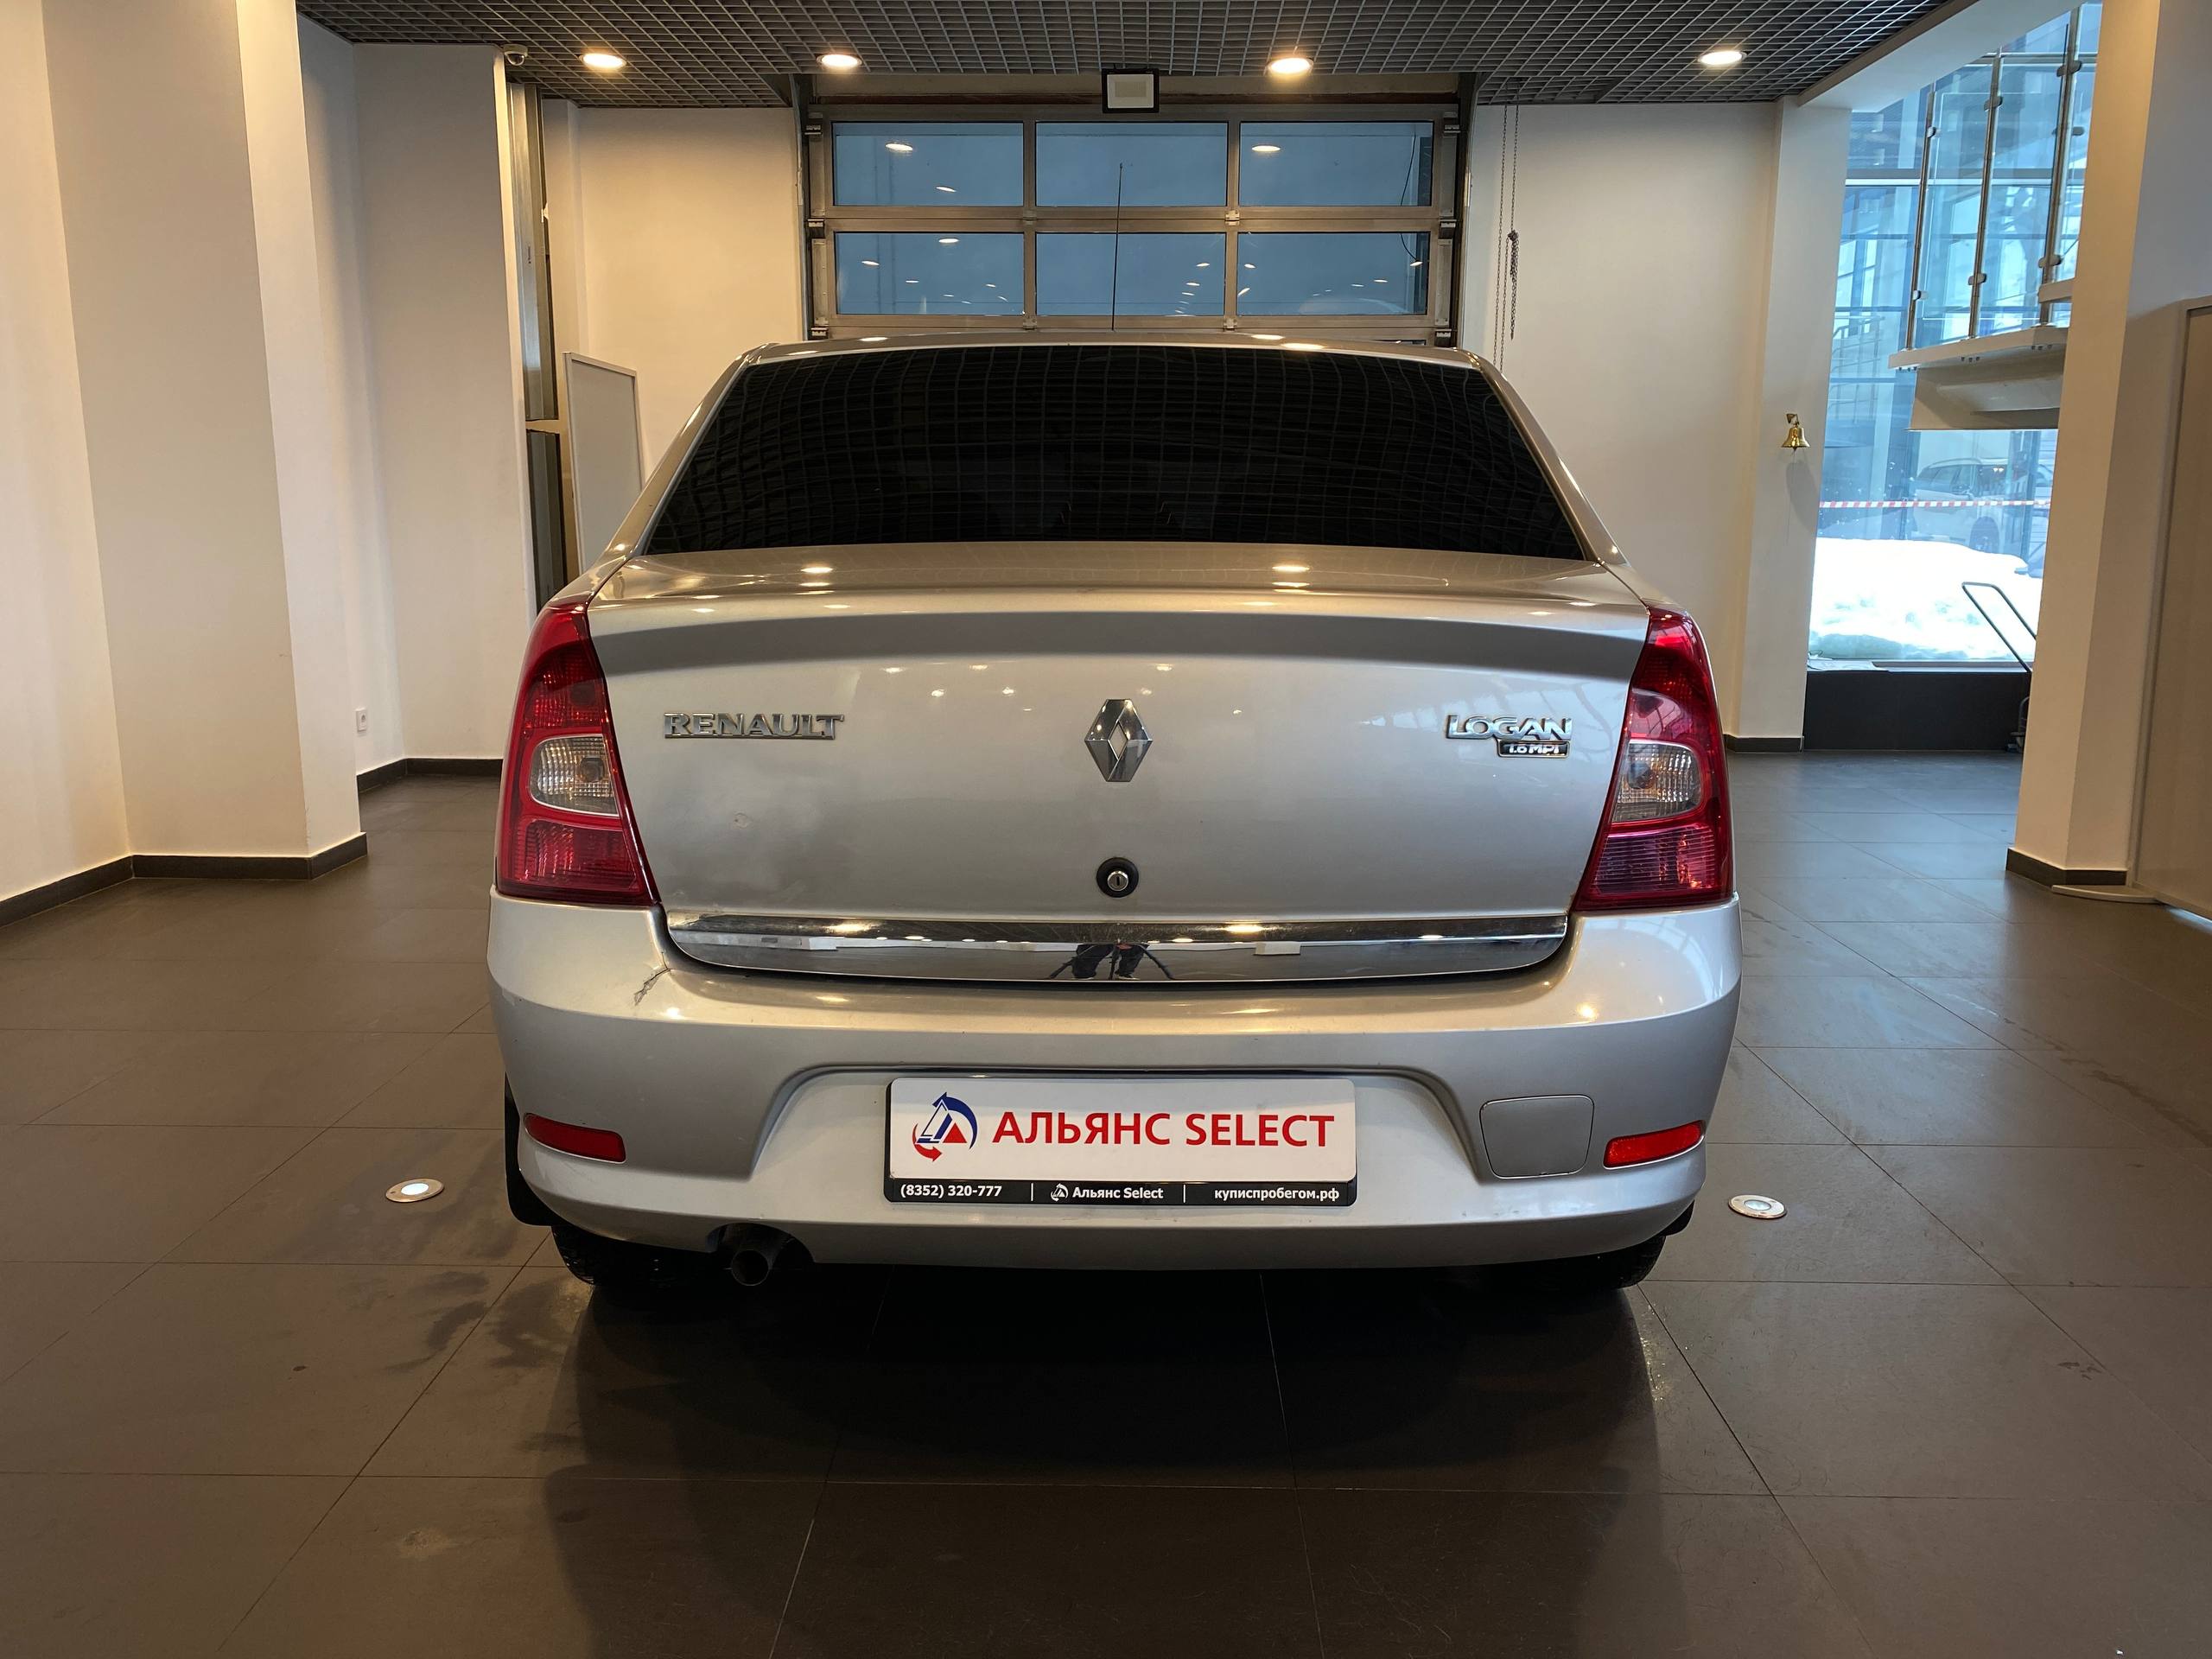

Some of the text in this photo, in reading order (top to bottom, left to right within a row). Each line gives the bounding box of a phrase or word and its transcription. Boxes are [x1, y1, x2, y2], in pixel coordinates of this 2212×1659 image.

[664, 713, 844, 739] RENAULT
[1446, 715, 1573, 741] LOGAN
[992, 1111, 1335, 1147] АЛЬЯНС SELECT
[900, 1184, 1002, 1198] (8352) 320-777
[1072, 1186, 1164, 1199] Альянс Select
[1214, 1187, 1340, 1202] куписпробегом.рф
